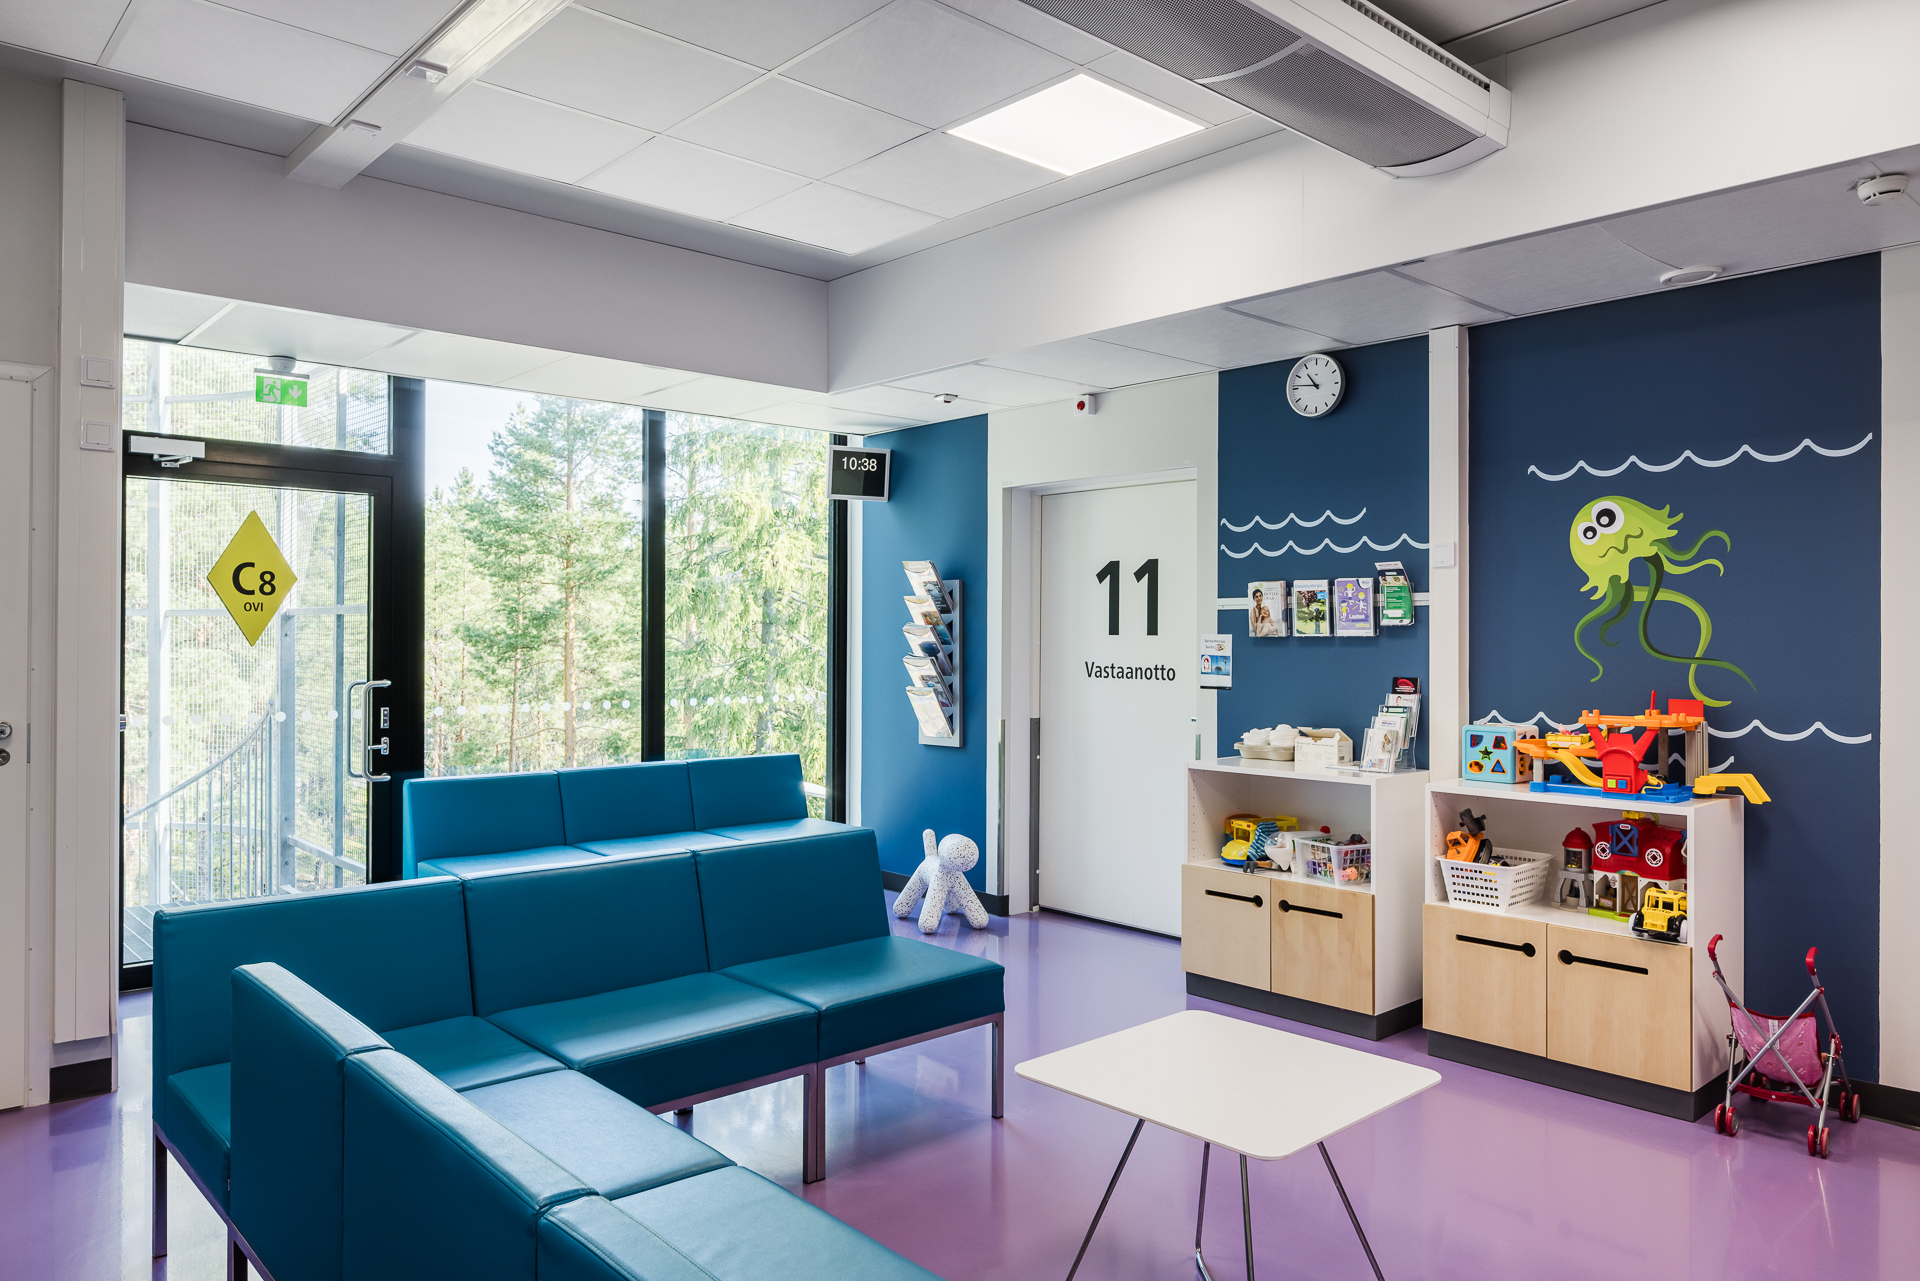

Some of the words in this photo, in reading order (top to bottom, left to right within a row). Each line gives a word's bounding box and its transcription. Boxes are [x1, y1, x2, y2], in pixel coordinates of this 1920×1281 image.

[842, 456, 877, 472] 10:38
[232, 561, 277, 596] C8
[243, 601, 264, 612] OVI
[1096, 558, 1159, 636] 11
[1084, 661, 1176, 682] Vastaanotto
